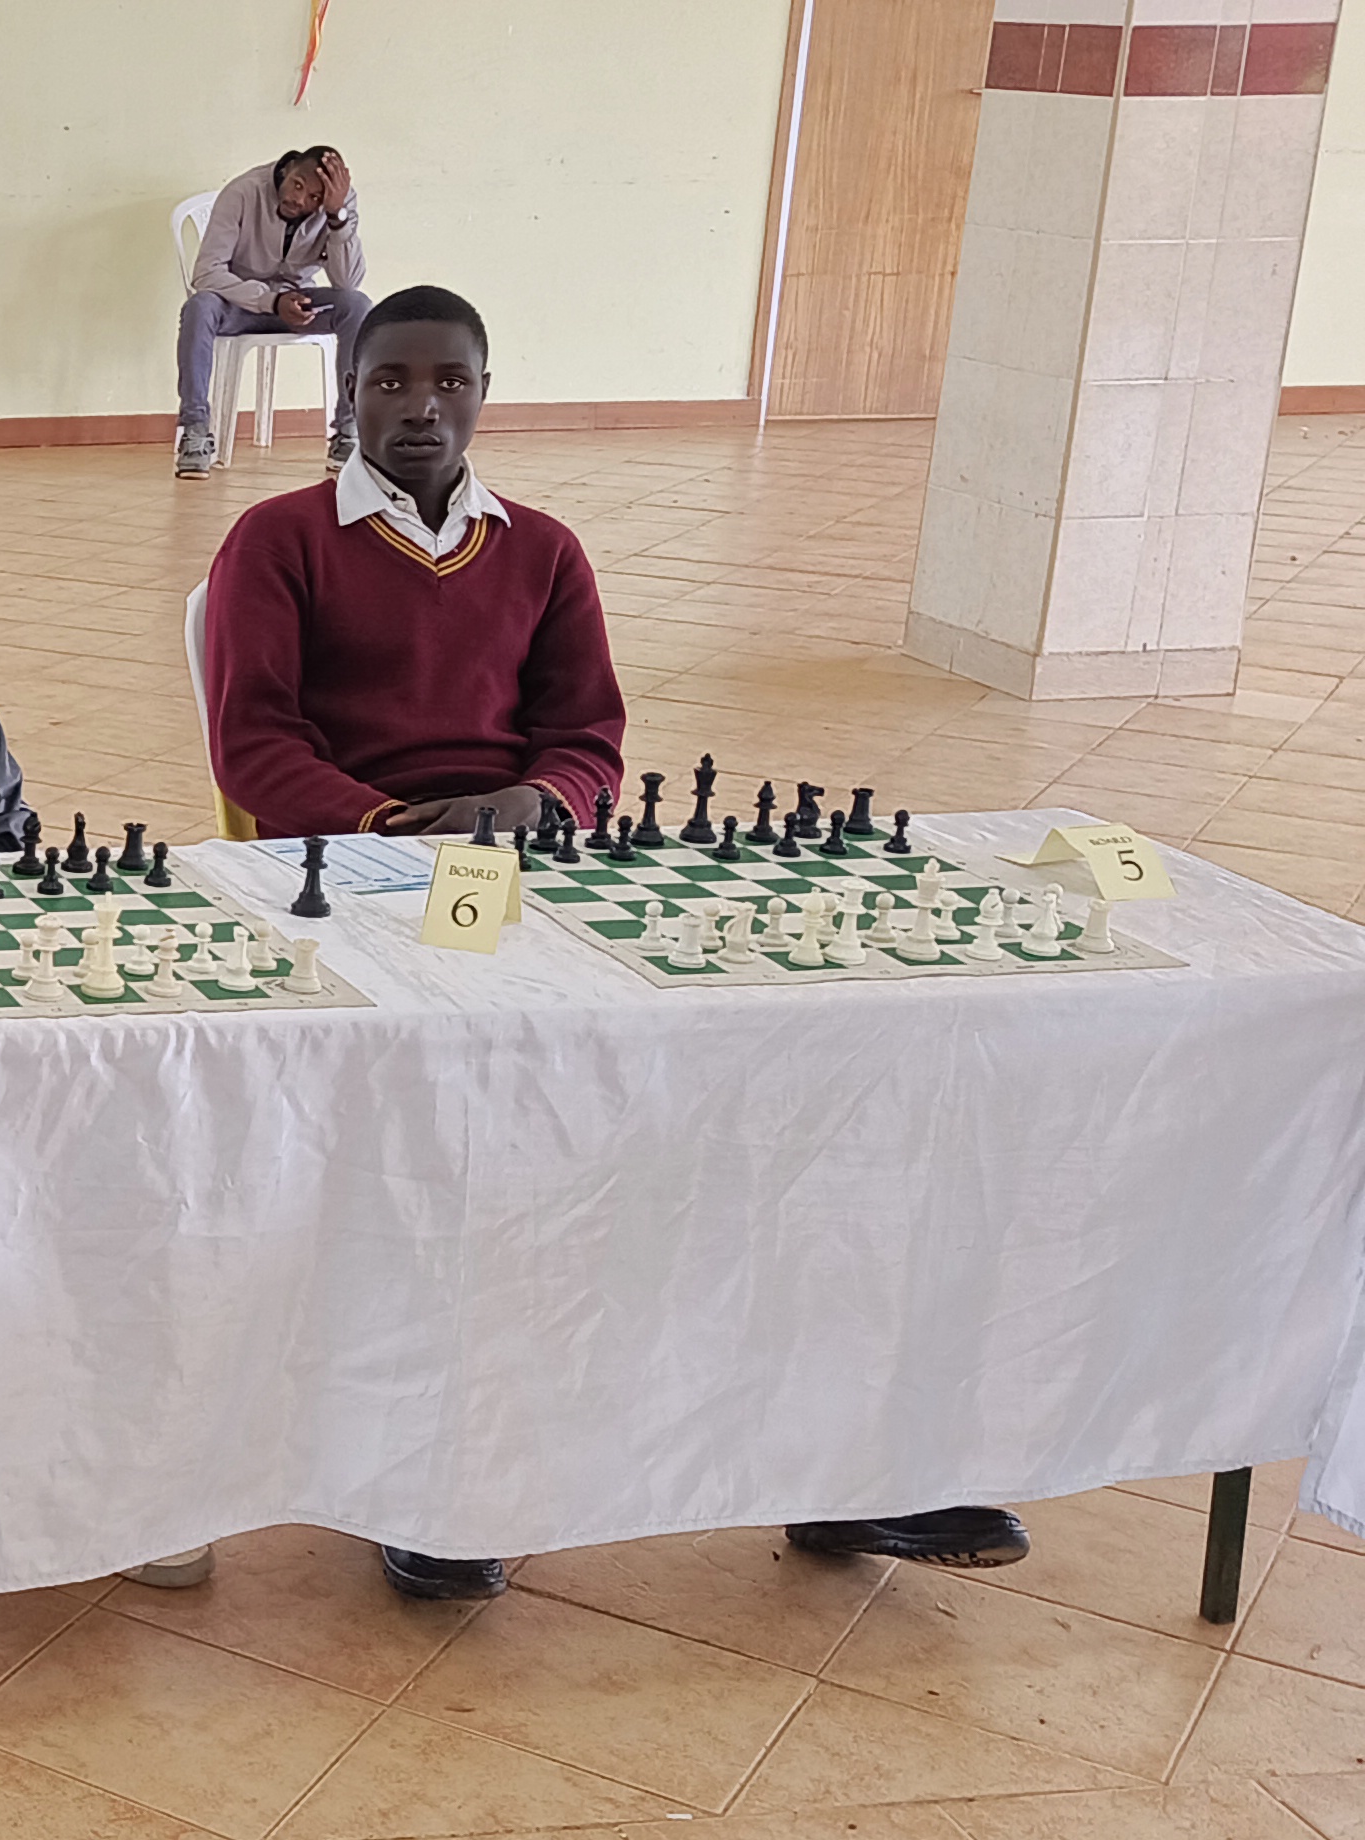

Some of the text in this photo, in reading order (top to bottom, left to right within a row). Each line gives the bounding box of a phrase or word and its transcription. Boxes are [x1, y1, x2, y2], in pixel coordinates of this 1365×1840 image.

[448, 864, 499, 881] BOARD
[1117, 849, 1144, 882] 5
[451, 891, 479, 928] 6
